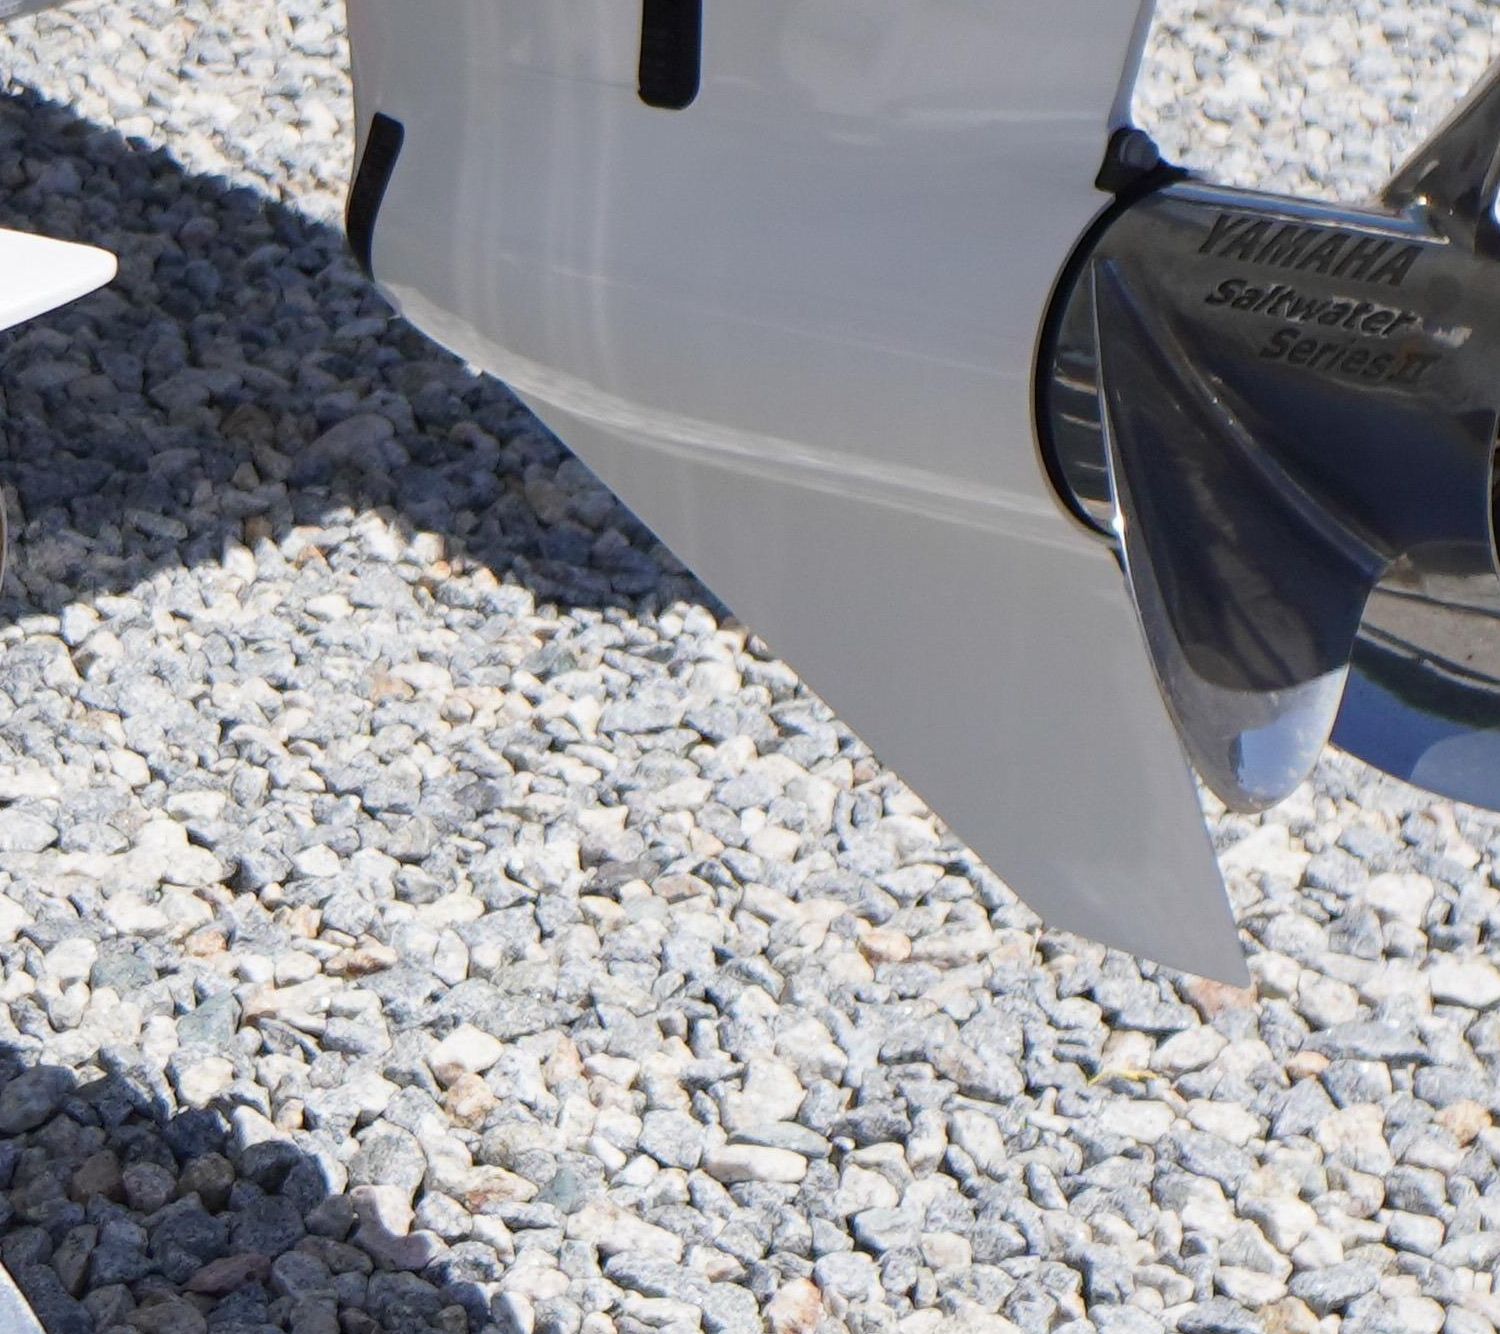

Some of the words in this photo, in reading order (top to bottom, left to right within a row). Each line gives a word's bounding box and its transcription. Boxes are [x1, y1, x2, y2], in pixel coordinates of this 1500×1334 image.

[1197, 213, 1425, 287] YAMAHA
[1204, 278, 1418, 338] Saltwater
[1259, 326, 1393, 379] Series
